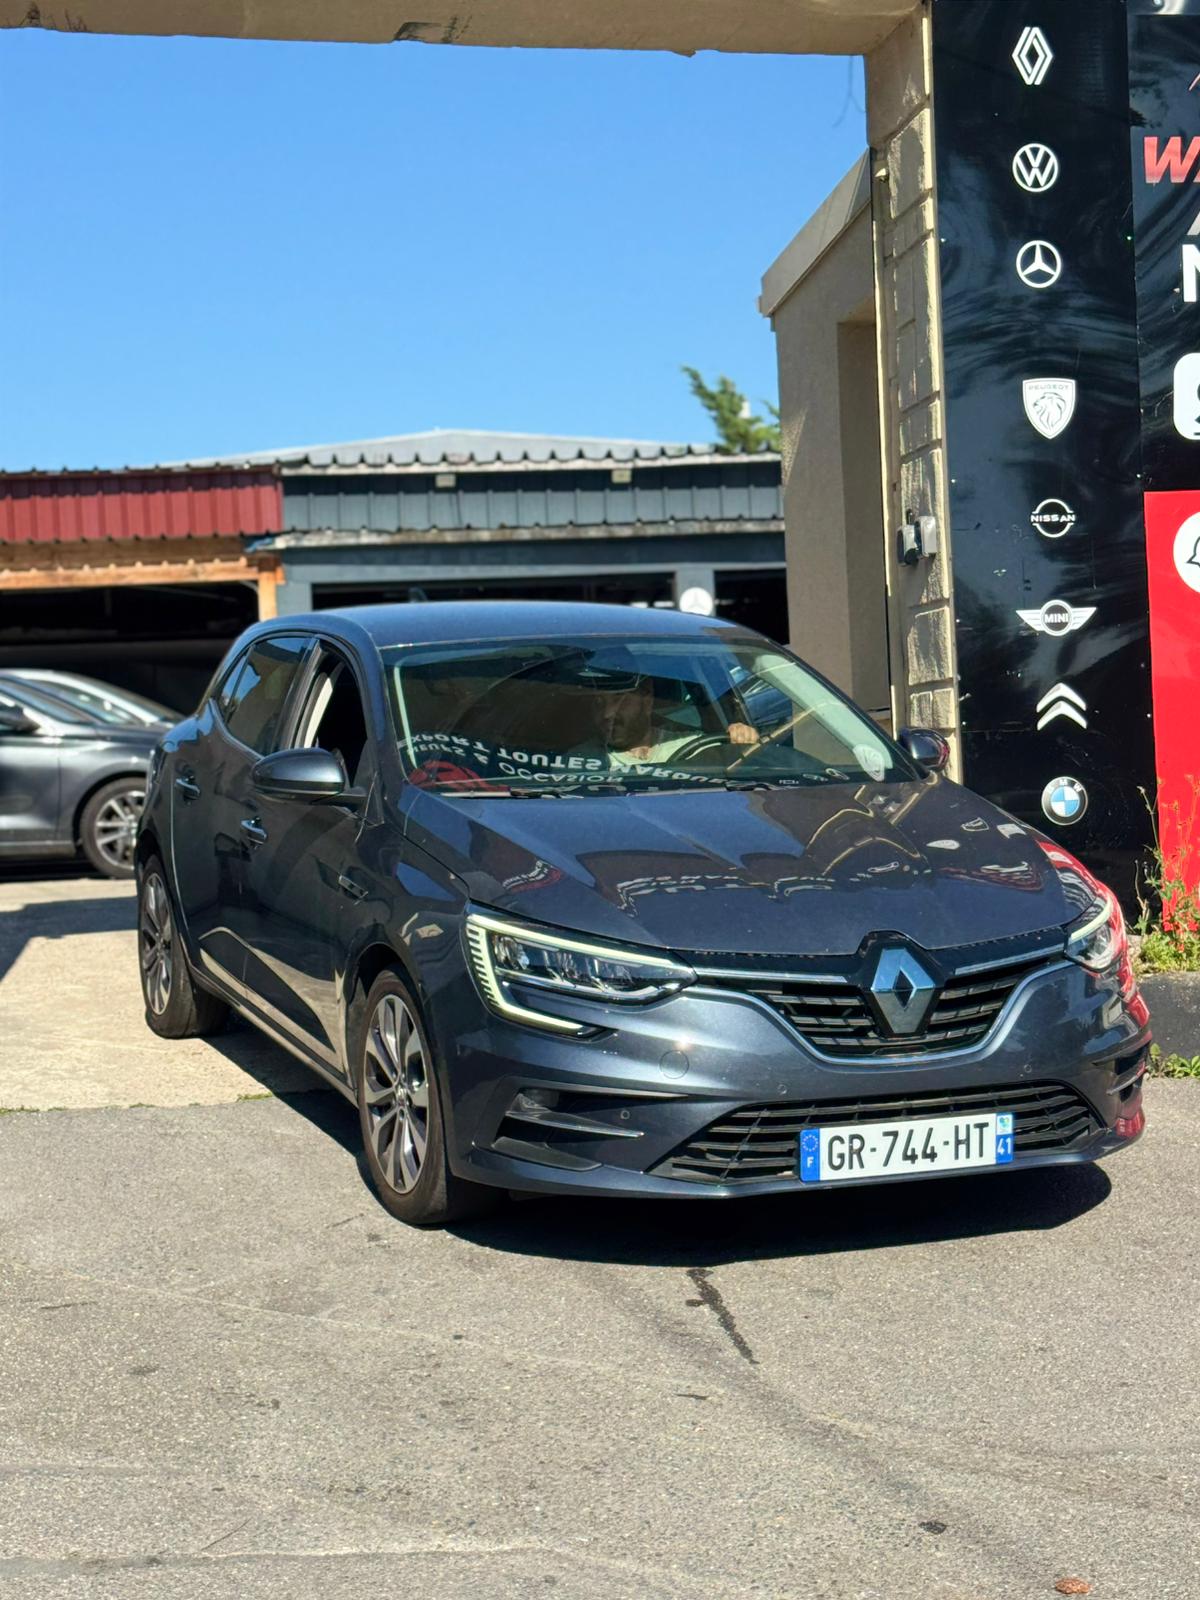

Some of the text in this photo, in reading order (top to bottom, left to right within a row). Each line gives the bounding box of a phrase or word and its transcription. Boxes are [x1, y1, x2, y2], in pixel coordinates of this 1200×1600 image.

[1143, 136, 1200, 184] W
[1030, 514, 1076, 523] NISSAN
[1044, 613, 1069, 623] MINI
[806, 1121, 990, 1171] F GR-744-HT
[997, 1137, 1012, 1156] 41
